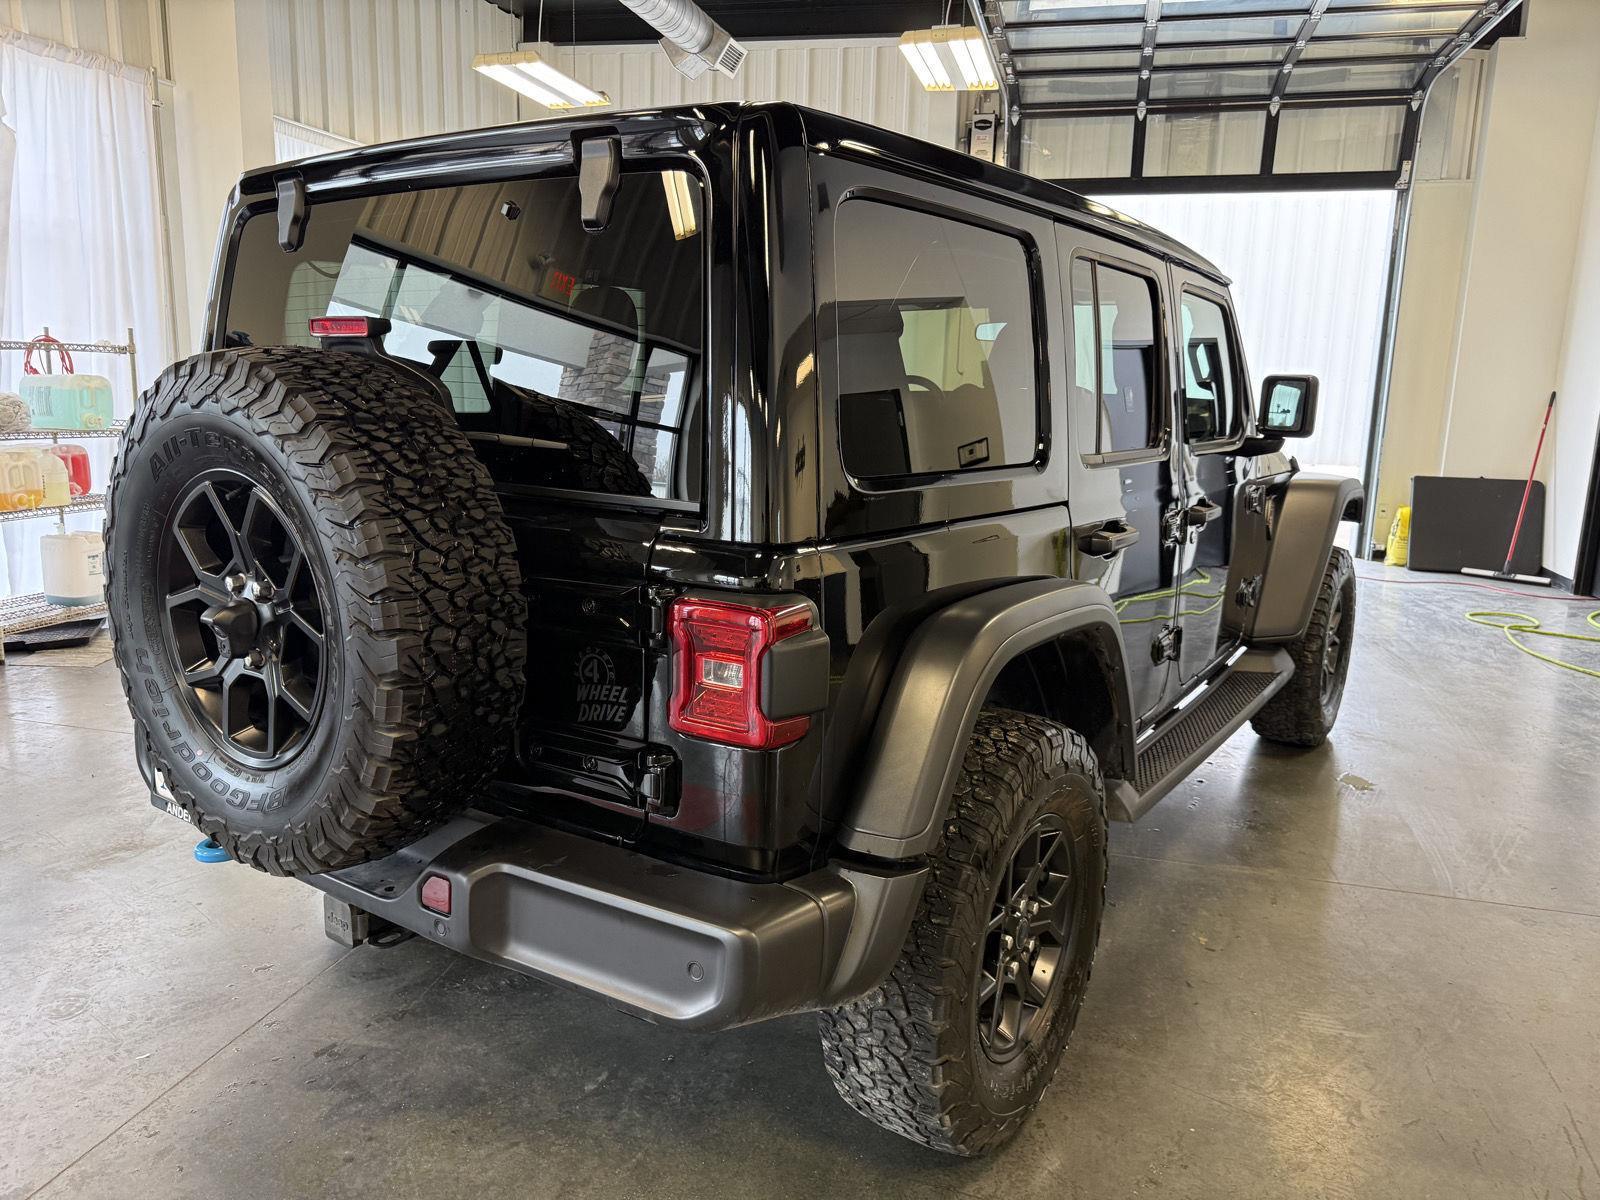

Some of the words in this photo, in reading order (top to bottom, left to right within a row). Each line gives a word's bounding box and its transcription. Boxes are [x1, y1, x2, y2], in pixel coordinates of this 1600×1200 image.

[584, 658, 600, 683] 4
[577, 684, 628, 703] WHEEL
[578, 703, 627, 722] DRIVE
[136, 648, 288, 813] BFGoodrich
